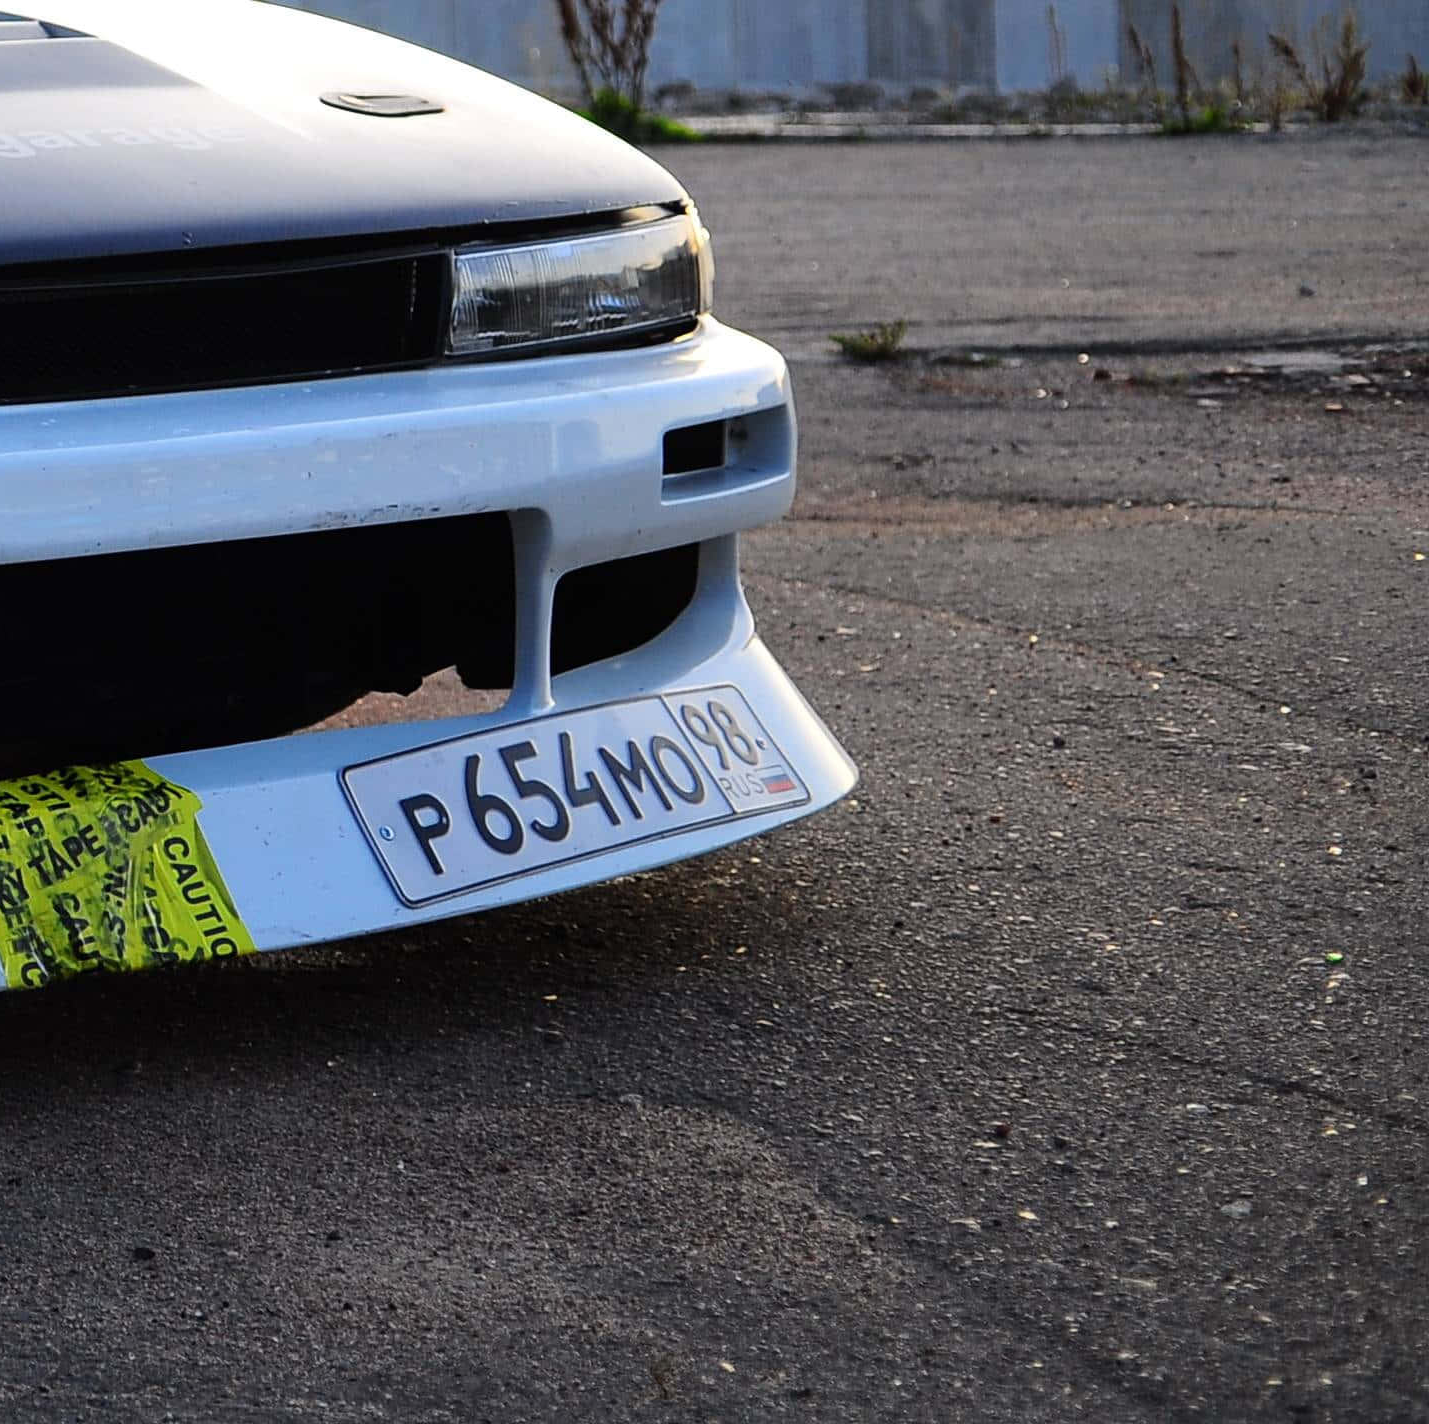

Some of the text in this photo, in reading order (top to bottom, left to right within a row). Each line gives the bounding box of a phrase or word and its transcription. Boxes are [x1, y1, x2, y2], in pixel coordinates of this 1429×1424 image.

[681, 701, 758, 770] 98
[718, 773, 764, 799] RUS
[28, 824, 106, 886] TAPE
